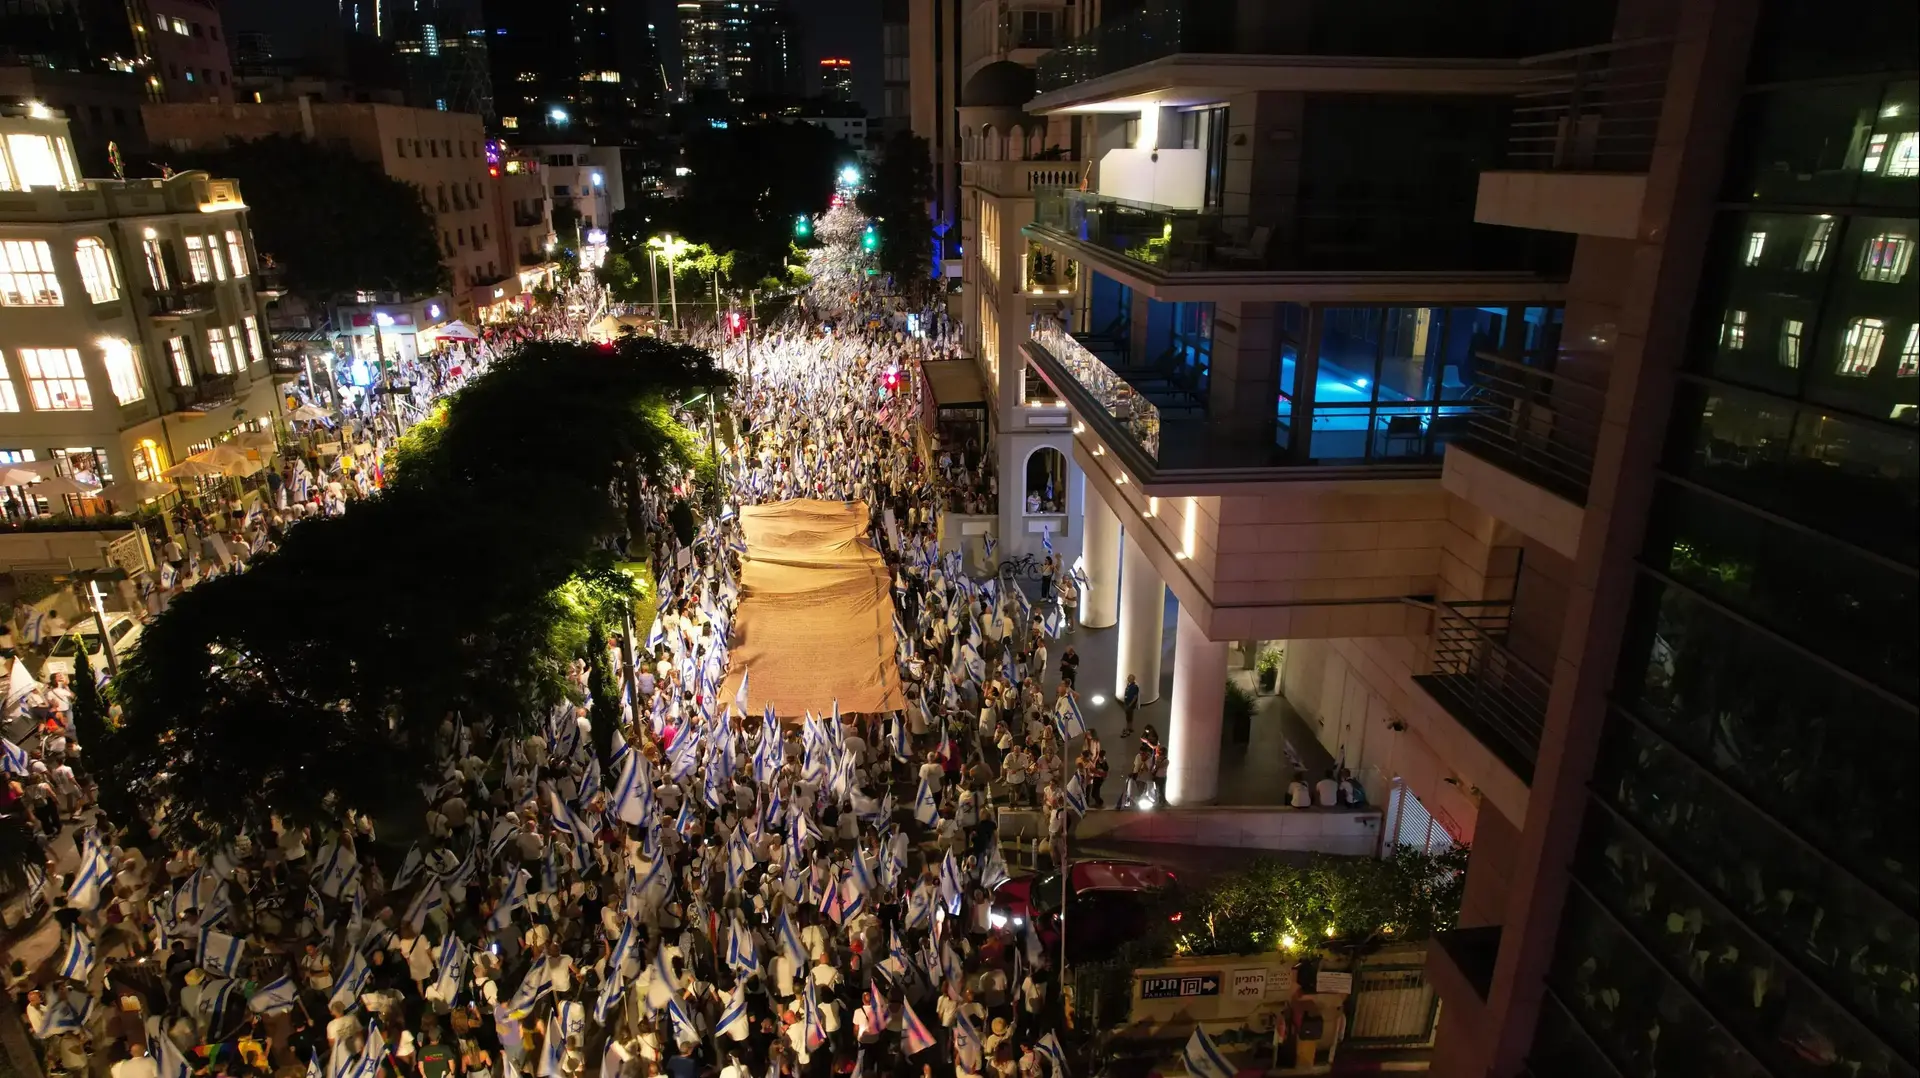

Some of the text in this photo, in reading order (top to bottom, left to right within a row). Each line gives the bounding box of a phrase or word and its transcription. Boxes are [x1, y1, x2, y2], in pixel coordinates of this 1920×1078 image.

[1235, 975, 1264, 986] החניון
[1145, 979, 1178, 994] חניון
[1238, 985, 1259, 996] מלא
